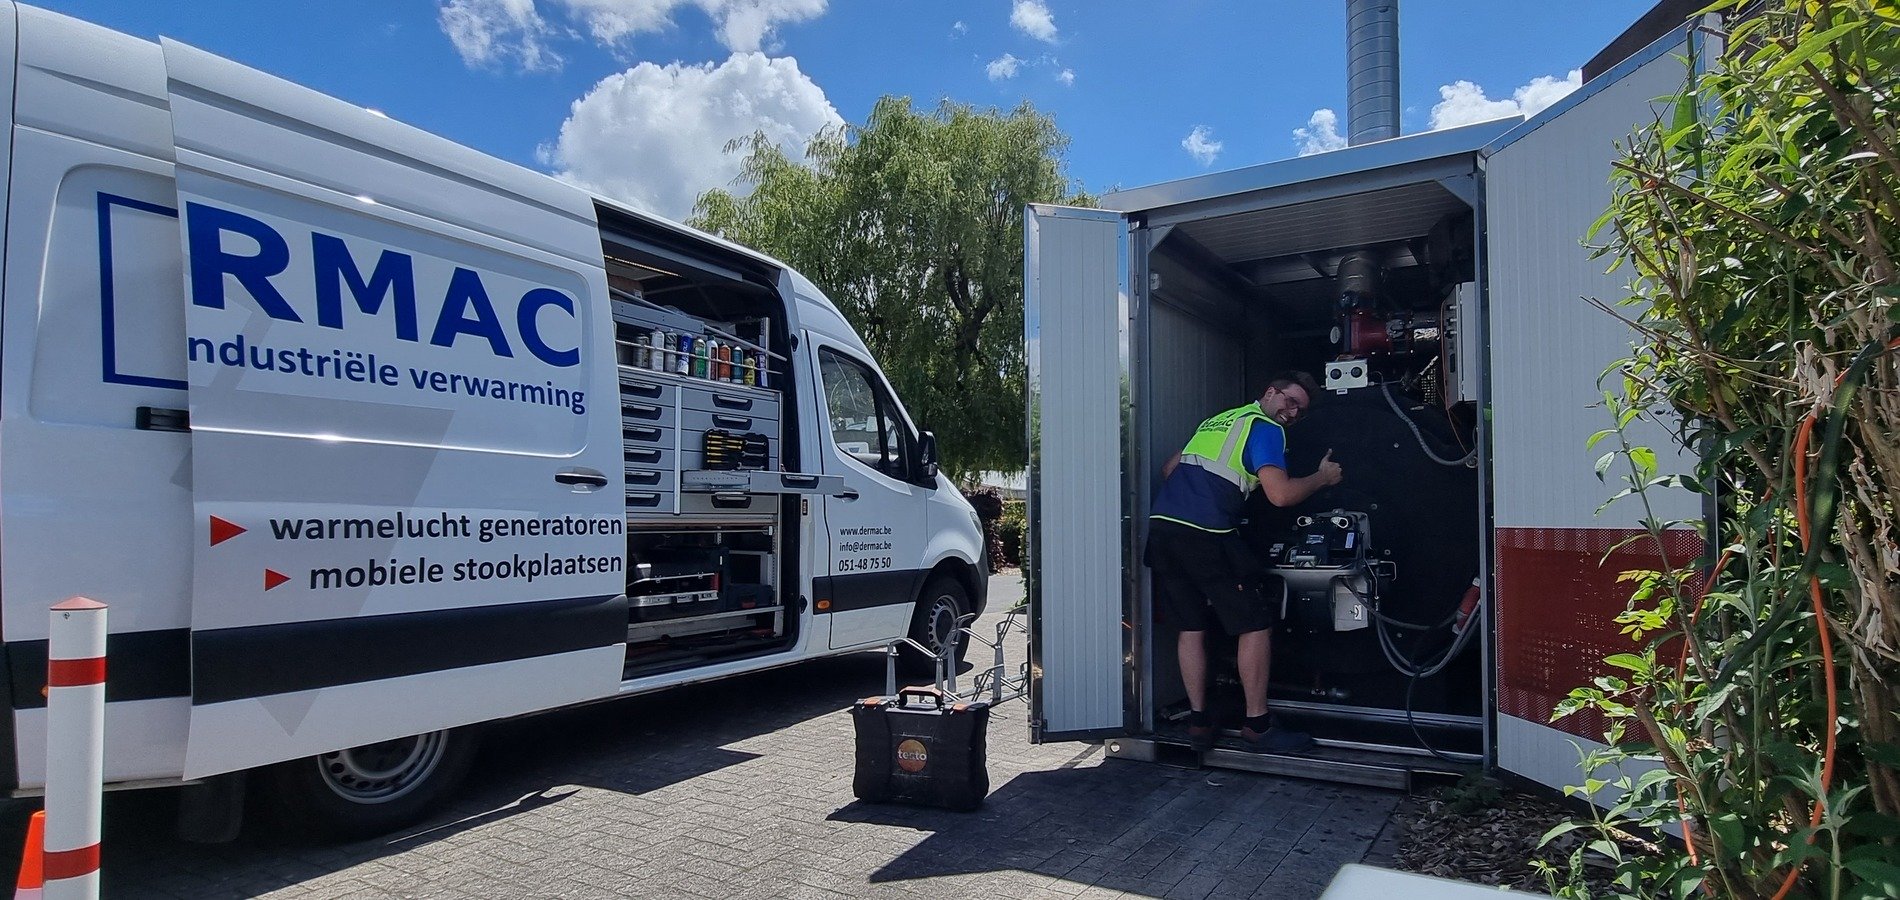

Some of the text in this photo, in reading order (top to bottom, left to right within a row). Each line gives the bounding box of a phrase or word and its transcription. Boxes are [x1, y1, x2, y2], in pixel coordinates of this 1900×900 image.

[186, 201, 581, 368] RMAC
[409, 368, 586, 415] verwarming
[269, 512, 622, 543] warmelucht generatoren
[840, 526, 892, 536] www.dermac.be
[839, 541, 892, 552] info@dermac.be
[309, 553, 622, 589] mobiele stookplaatsen
[838, 556, 892, 572] 051-48 75 50
[897, 748, 927, 761] testo
